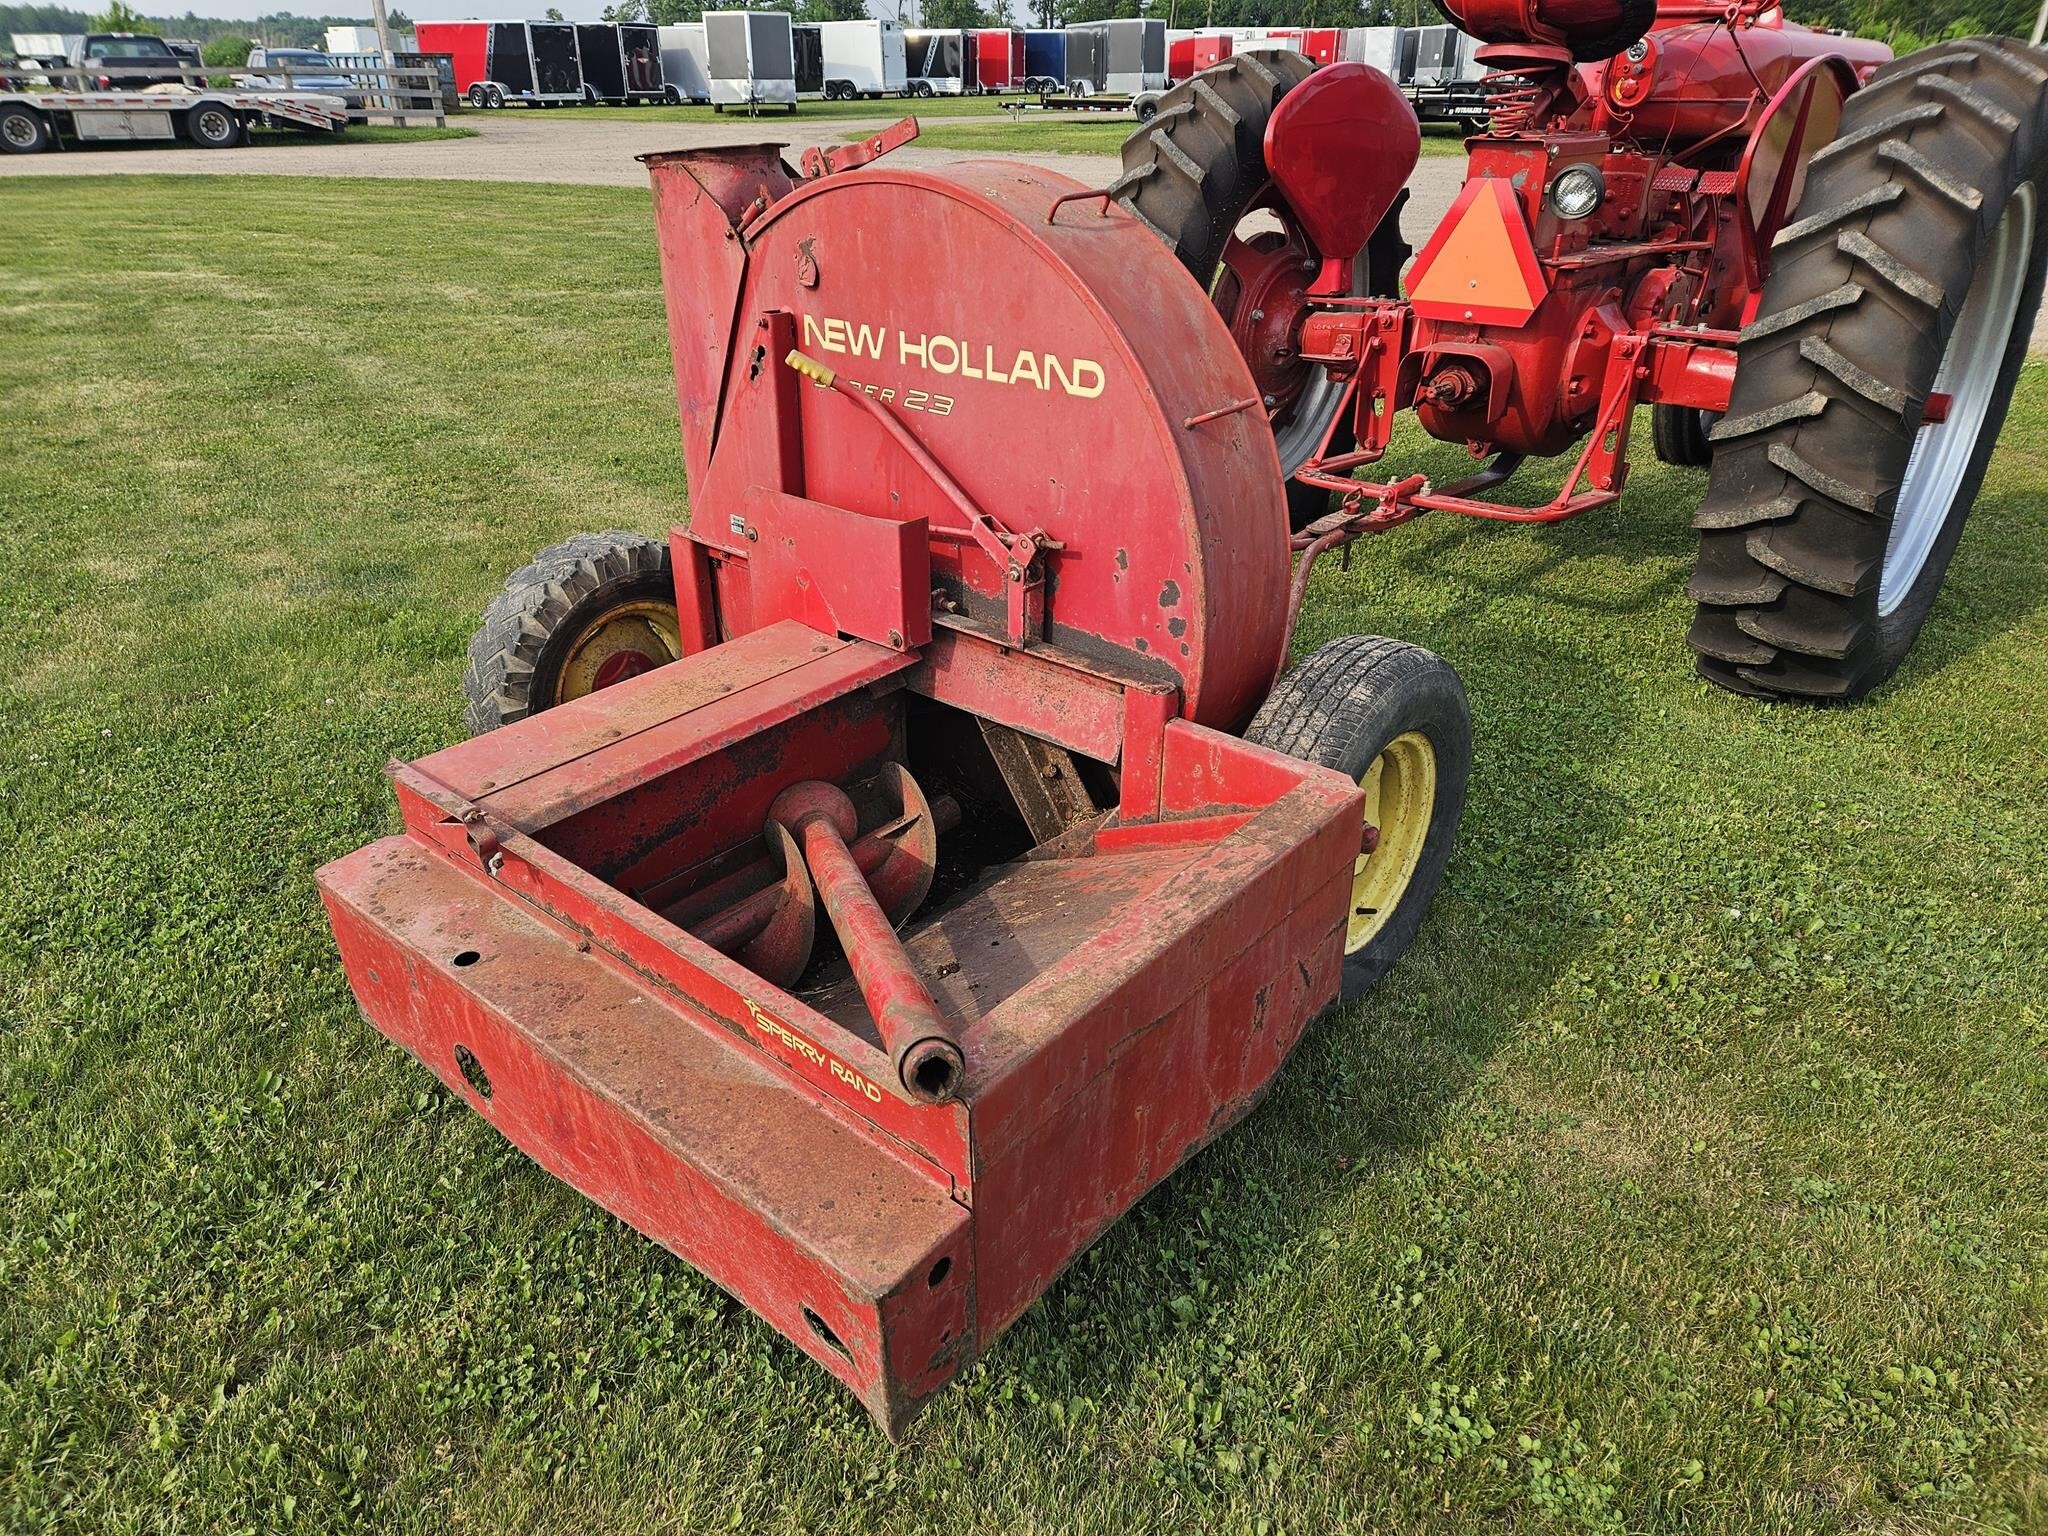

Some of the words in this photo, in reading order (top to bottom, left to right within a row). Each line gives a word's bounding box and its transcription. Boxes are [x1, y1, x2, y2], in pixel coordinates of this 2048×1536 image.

[803, 313, 886, 360] NEW
[899, 330, 1106, 399] HOLLAND
[903, 388, 955, 416] 23
[756, 1013, 826, 1067] SPERRY
[830, 1058, 881, 1103] RAND
